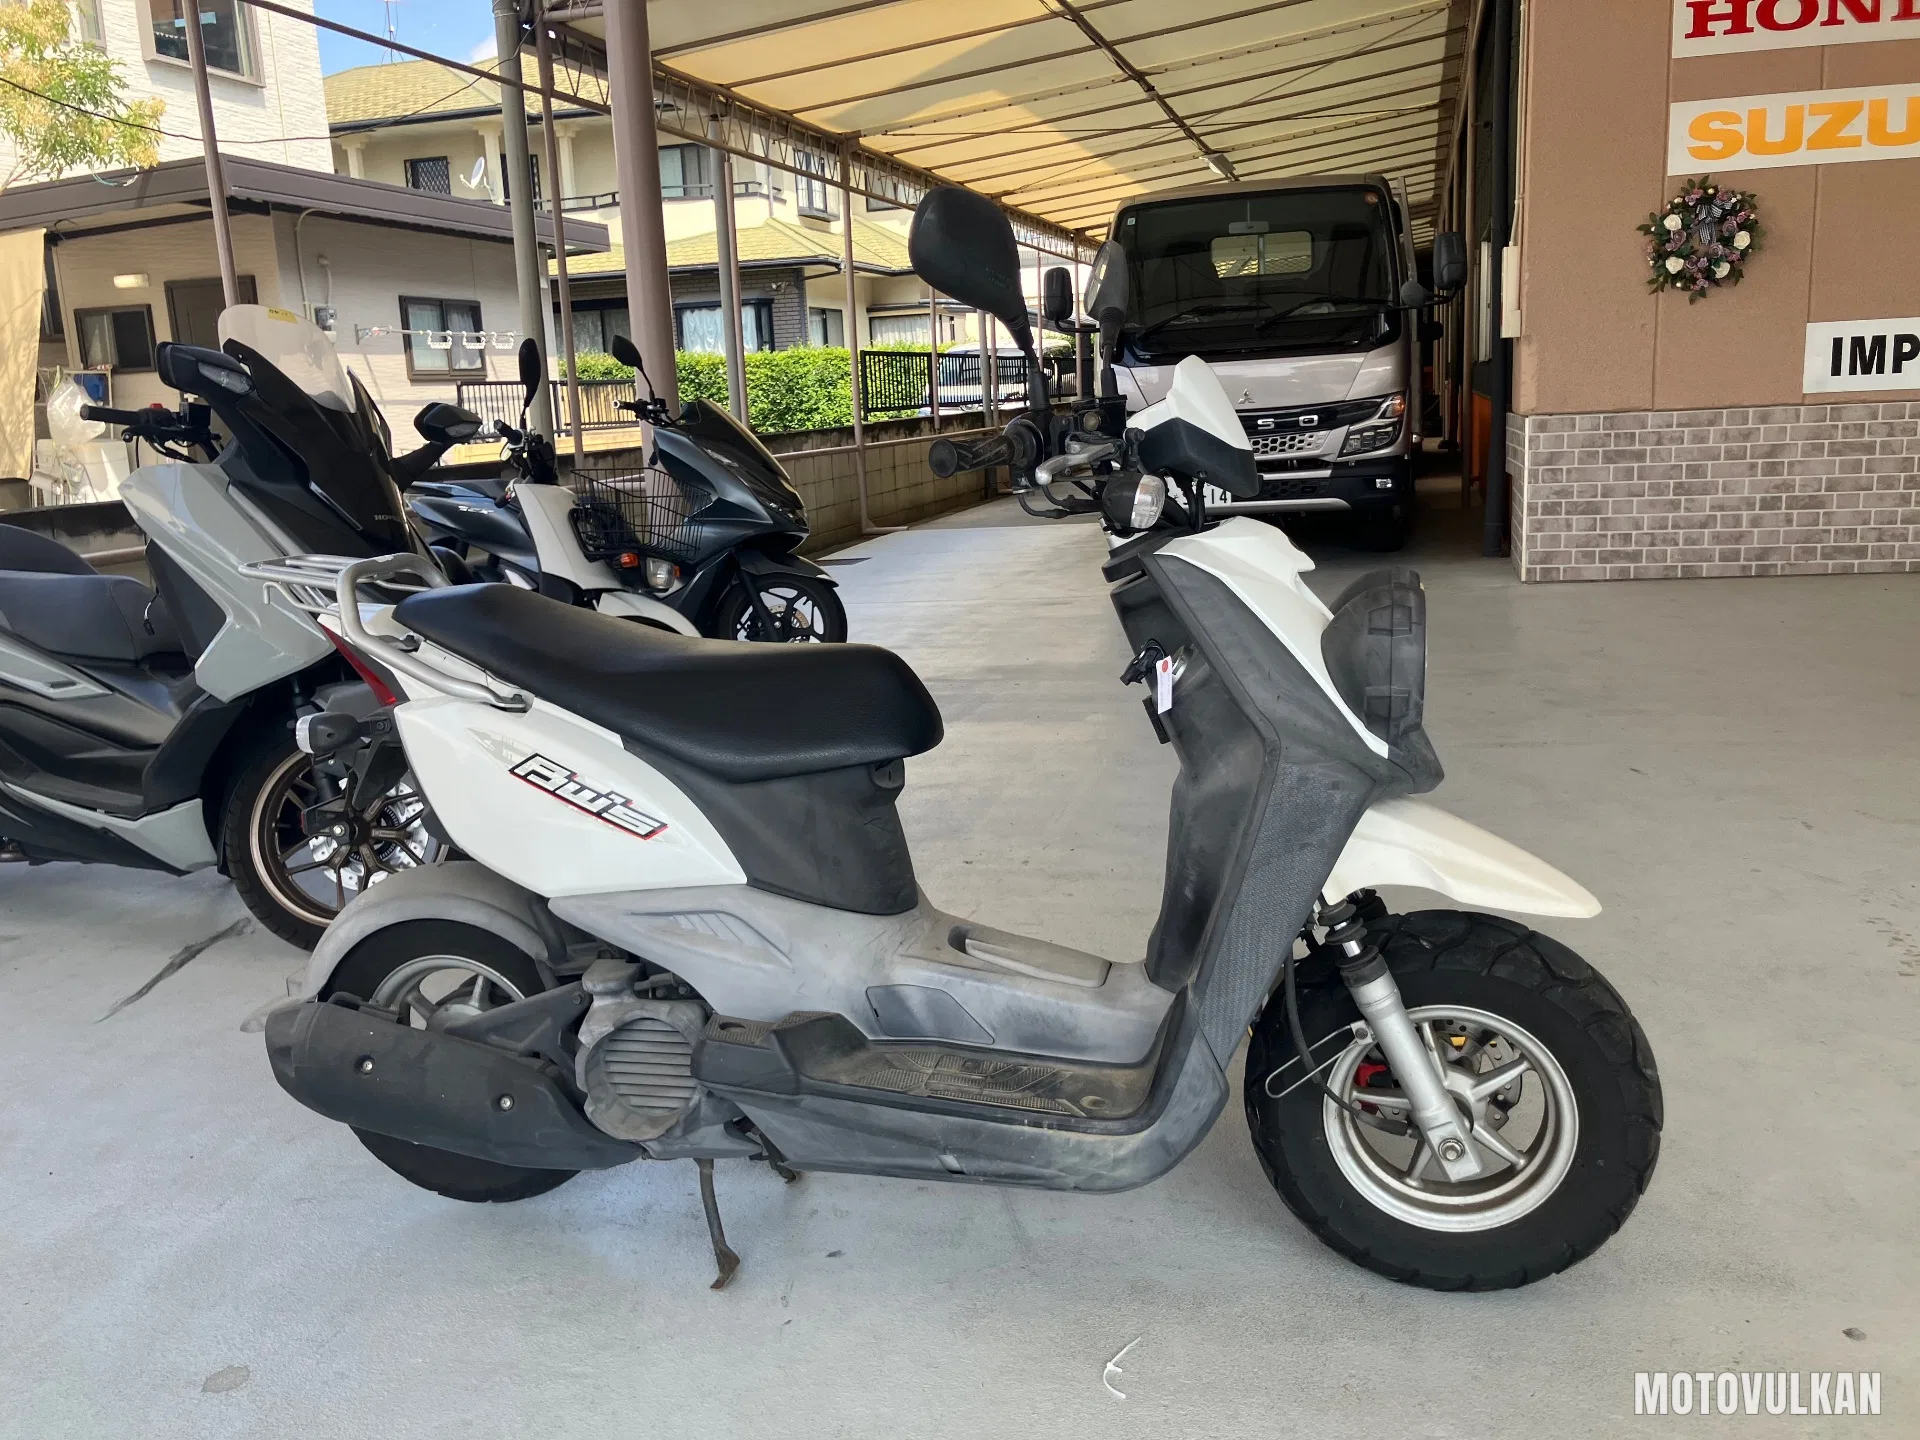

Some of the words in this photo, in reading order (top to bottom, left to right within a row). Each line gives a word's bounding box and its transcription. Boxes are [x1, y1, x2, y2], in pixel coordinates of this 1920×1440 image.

[1685, 0, 1920, 39] HON
[1687, 96, 1920, 160] SUZU
[1831, 333, 1920, 376] IMP
